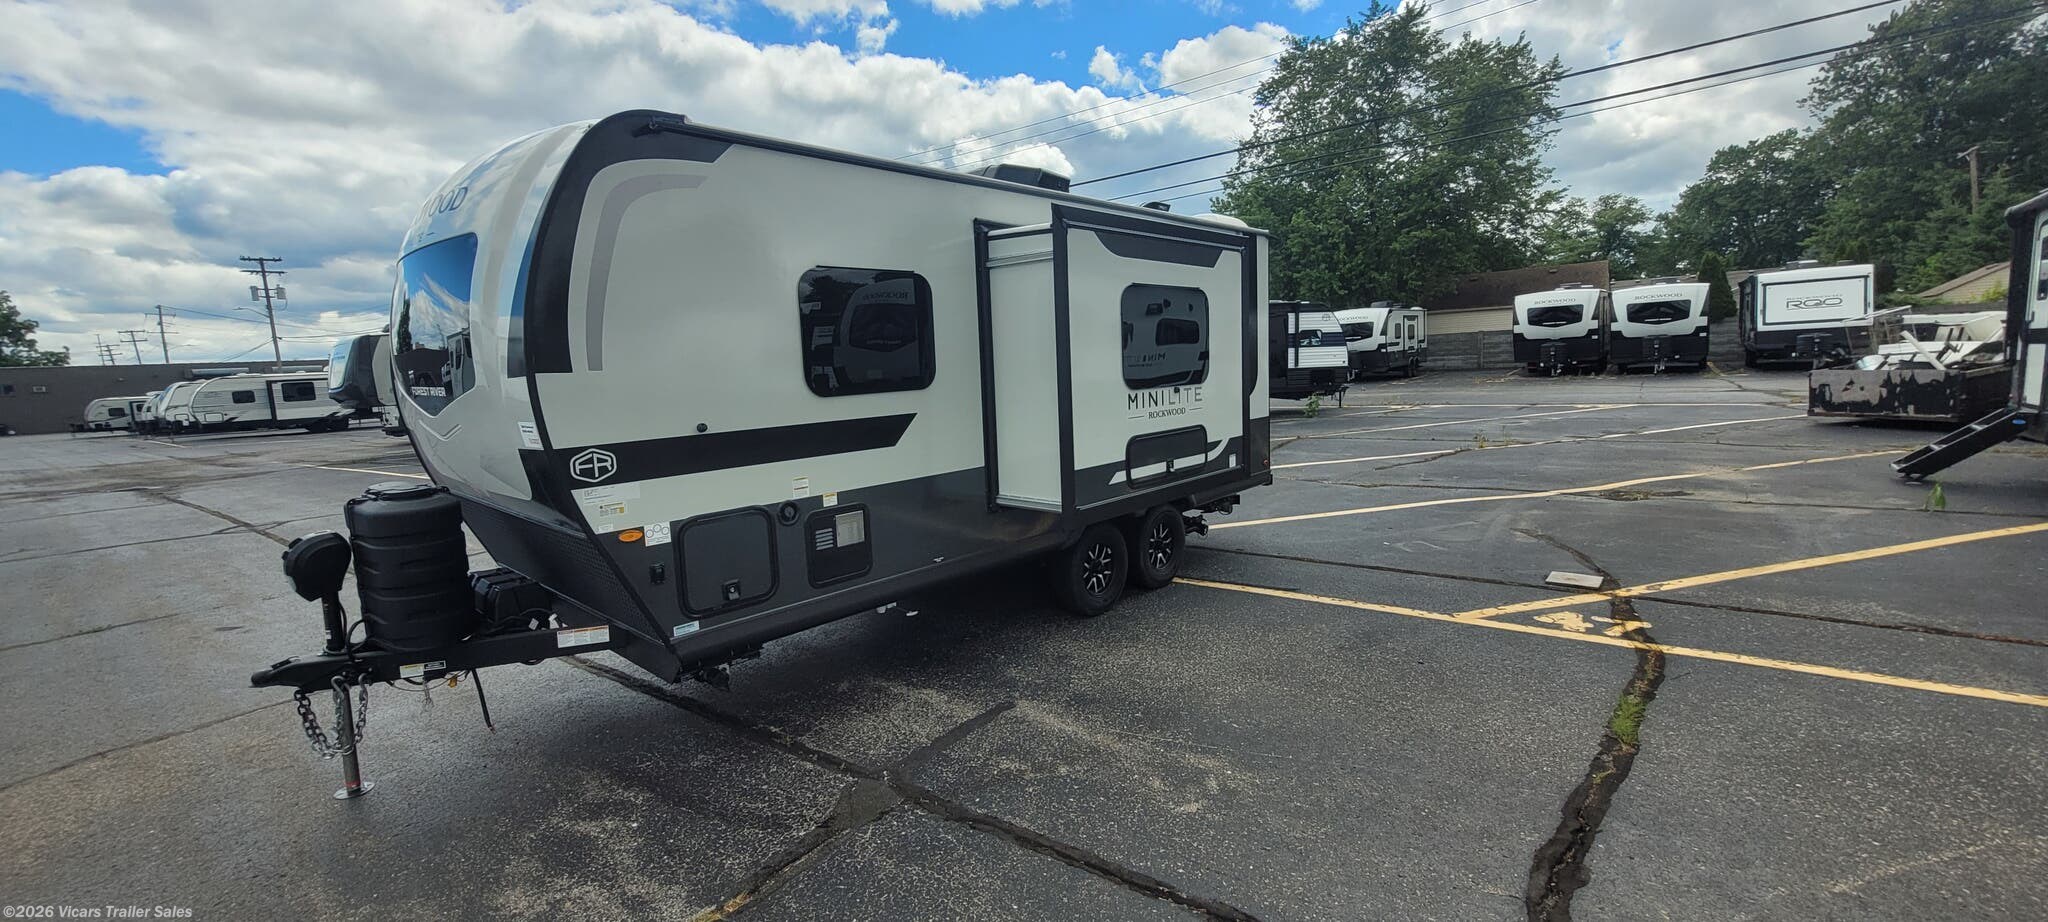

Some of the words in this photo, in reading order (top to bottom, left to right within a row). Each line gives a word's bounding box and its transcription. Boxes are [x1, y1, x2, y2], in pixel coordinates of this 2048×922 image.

[411, 386, 430, 399] FOREST
[430, 386, 447, 397] RIVER
[1148, 407, 1186, 419] ROCKWOOD
[574, 452, 613, 479] FR
